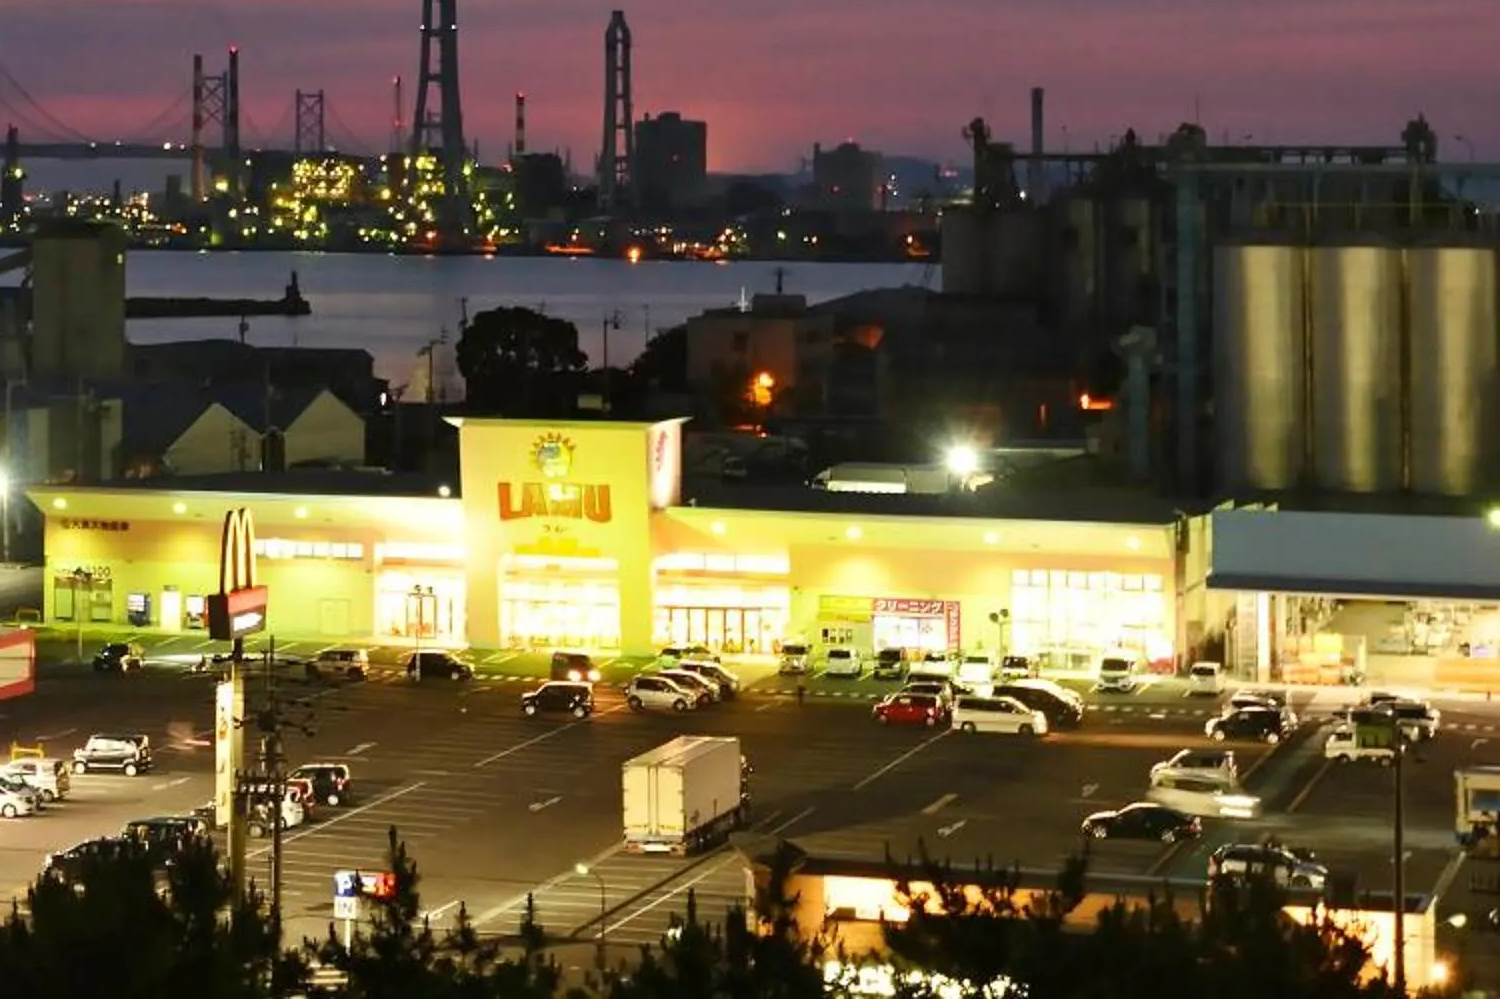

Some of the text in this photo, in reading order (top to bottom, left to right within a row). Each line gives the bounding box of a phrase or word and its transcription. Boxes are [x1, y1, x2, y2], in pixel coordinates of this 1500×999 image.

[877, 600, 944, 614] クリーニング
